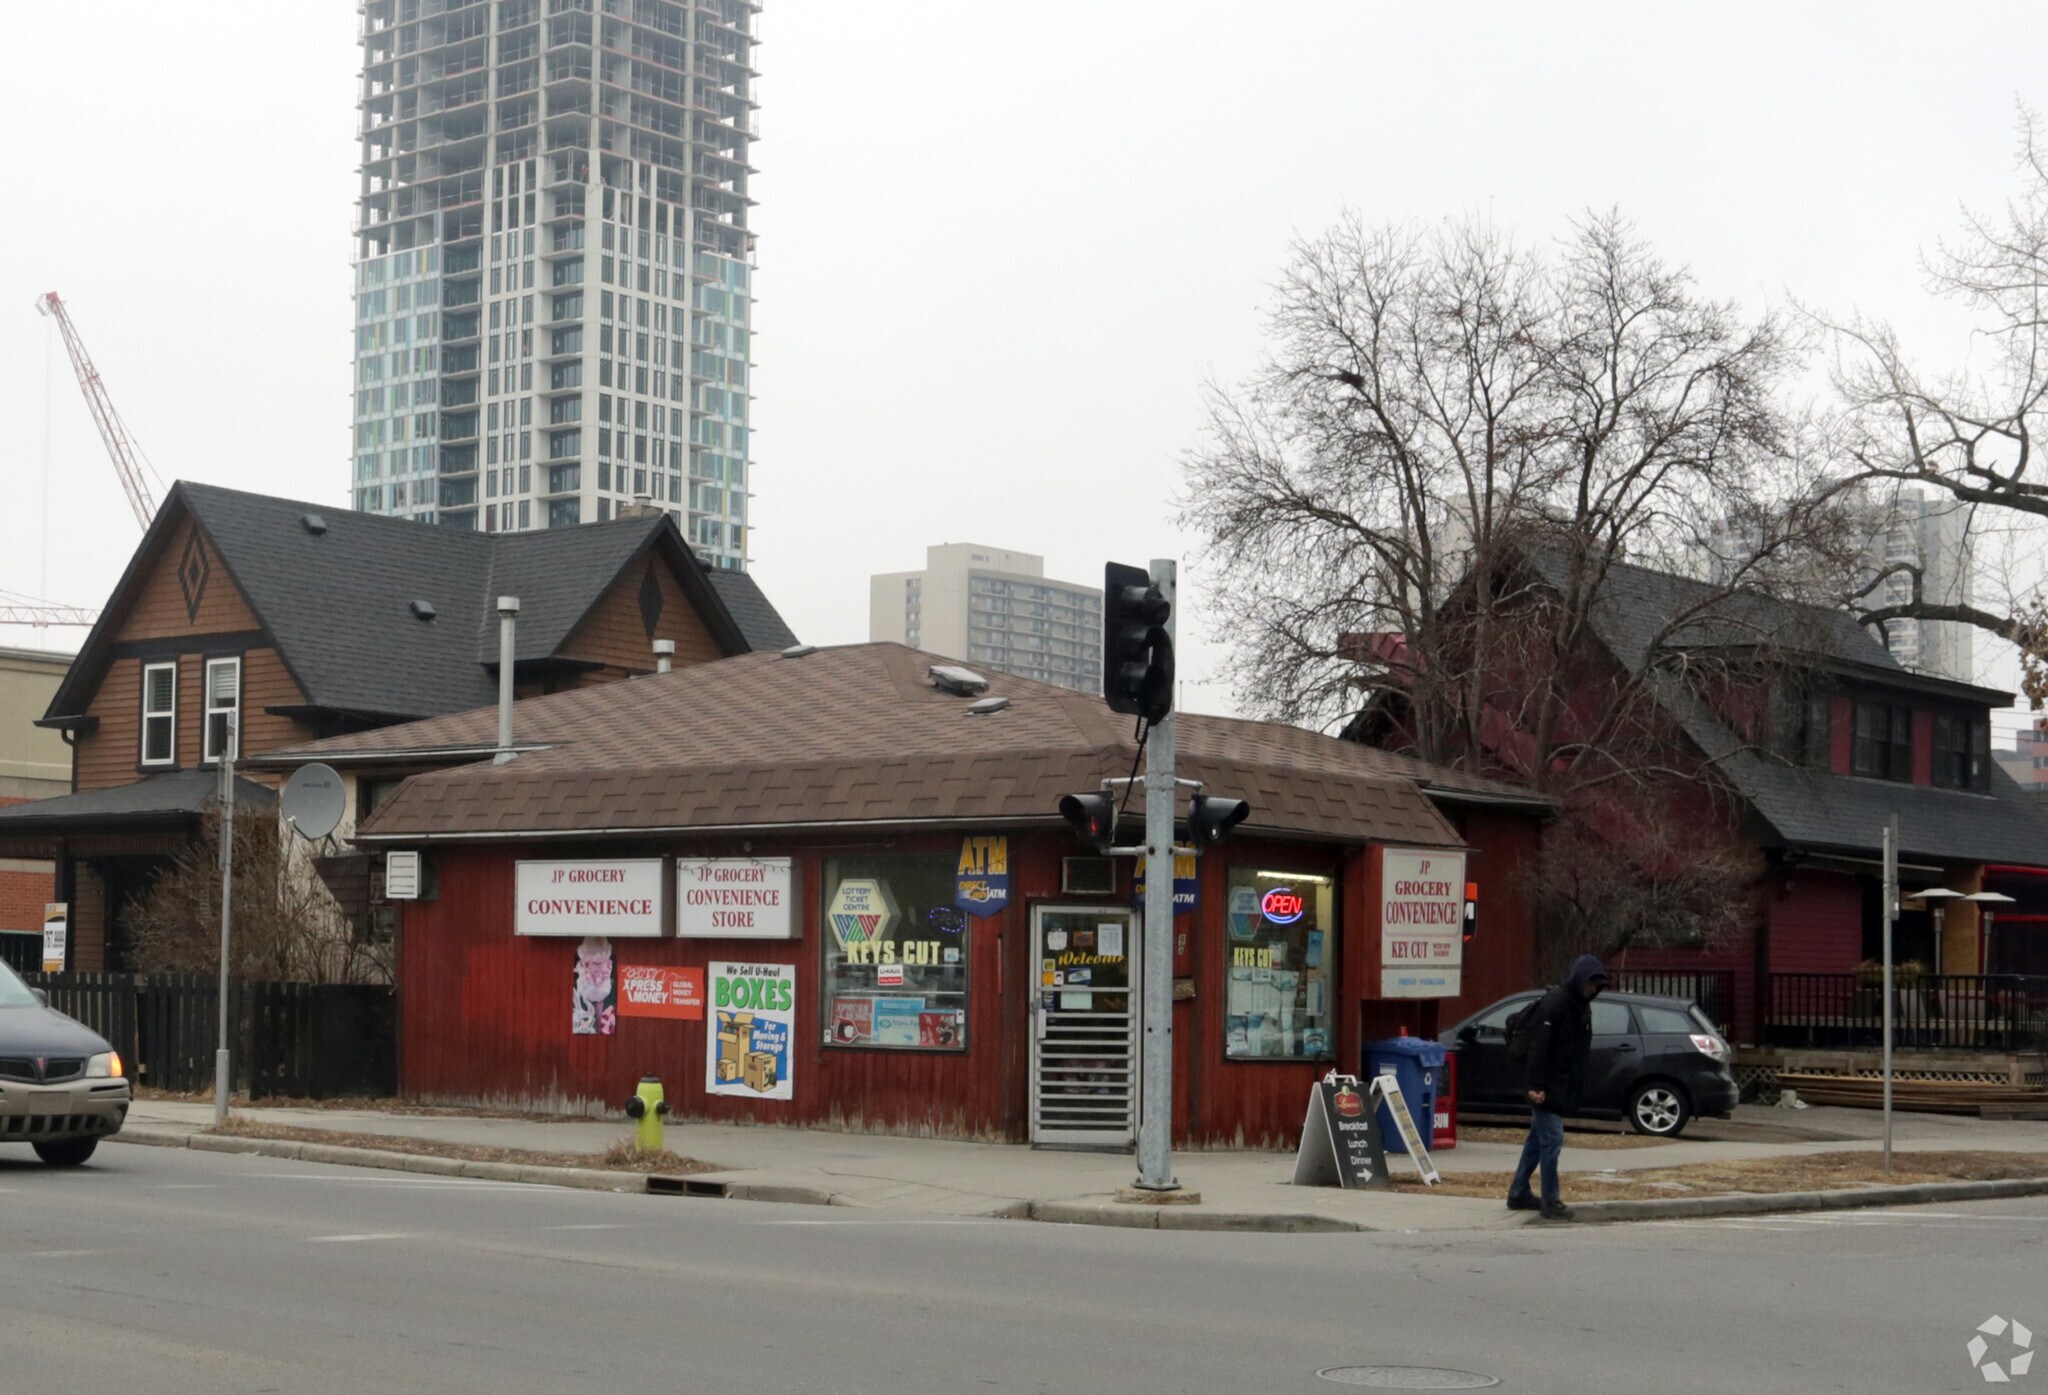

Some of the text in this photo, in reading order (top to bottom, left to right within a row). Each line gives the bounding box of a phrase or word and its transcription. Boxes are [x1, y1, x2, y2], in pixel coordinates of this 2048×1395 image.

[958, 836, 1007, 875] ATM
[1419, 860, 1431, 875] JP
[551, 869, 626, 883] JP GROCERY
[698, 868, 765, 882] JP GROCERY
[988, 889, 1006, 898] ATM
[1395, 881, 1452, 896] GROCERY
[687, 889, 779, 906] CONVENIENCE
[1265, 894, 1303, 914] OPEN
[528, 899, 653, 915] CONVENIENCE
[1386, 901, 1457, 925] CONVENIENCE
[712, 911, 755, 927] STORE
[847, 940, 941, 965] KEYS CUT
[1391, 941, 1428, 958] KEY CUT
[1058, 951, 1125, 966] Welcome
[1234, 947, 1273, 967] KEYS CUT
[726, 965, 780, 977] We Sell U-Haul
[623, 979, 663, 992] XPRESS
[672, 981, 694, 989] GLOBAL
[632, 991, 668, 1004] MONEY
[715, 976, 792, 1011] BOXES
[672, 998, 700, 1006] TRANSFER
[763, 1020, 777, 1031] For
[753, 1030, 787, 1043] Moving &
[756, 1041, 784, 1053] Storage
[1338, 1121, 1368, 1131] Breakfast
[1433, 1112, 1449, 1128] SUN
[1347, 1139, 1368, 1148] Lunch
[1350, 1156, 1372, 1165] Dinner
